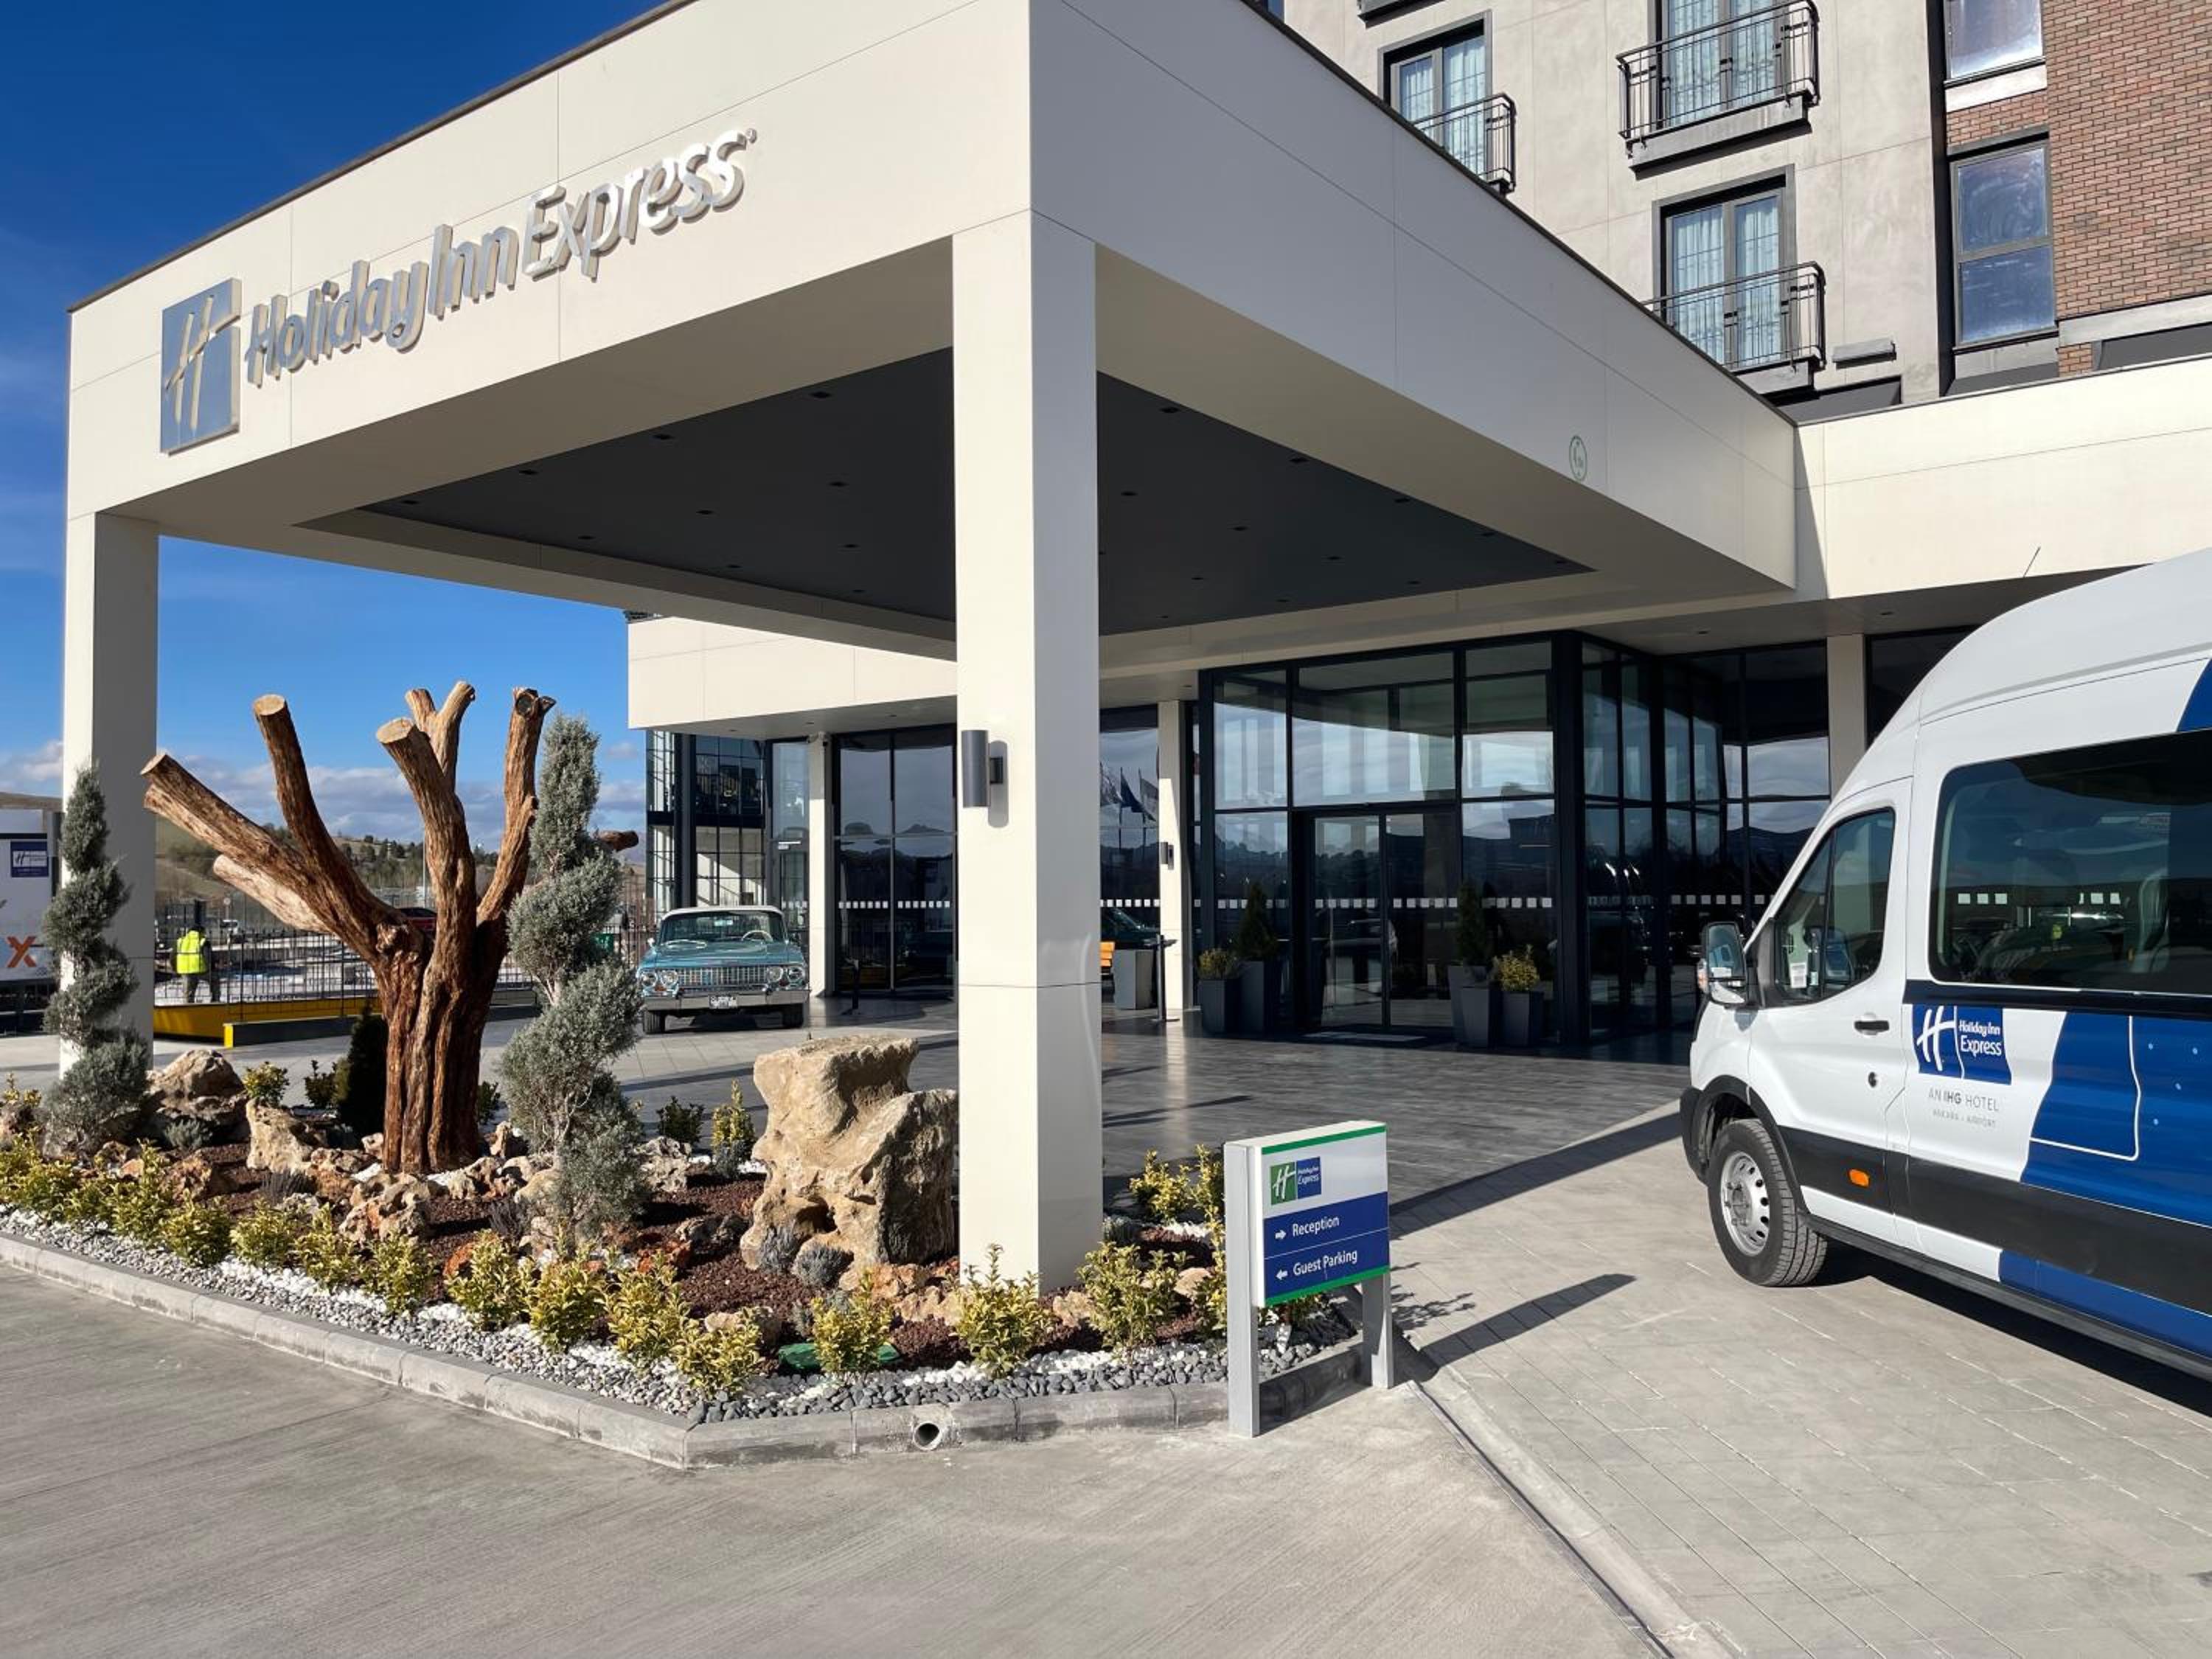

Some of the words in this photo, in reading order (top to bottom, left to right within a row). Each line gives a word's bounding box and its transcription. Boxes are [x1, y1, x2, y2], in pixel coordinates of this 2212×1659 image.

[246, 260, 429, 388] Holiday
[428, 224, 520, 319] Inn
[521, 129, 745, 281] Express
[1958, 1020, 1988, 1037] Holiday
[1988, 1022, 2000, 1035] Inn
[1961, 1035, 2002, 1057] Express
[1928, 1088, 1941, 1101] AN
[1943, 1090, 1962, 1105] IHG
[1965, 1094, 1999, 1112] HOTEL
[1292, 1216, 1340, 1237] Reception
[1293, 1259, 1321, 1276] Guest
[1323, 1251, 1358, 1269] Parking
